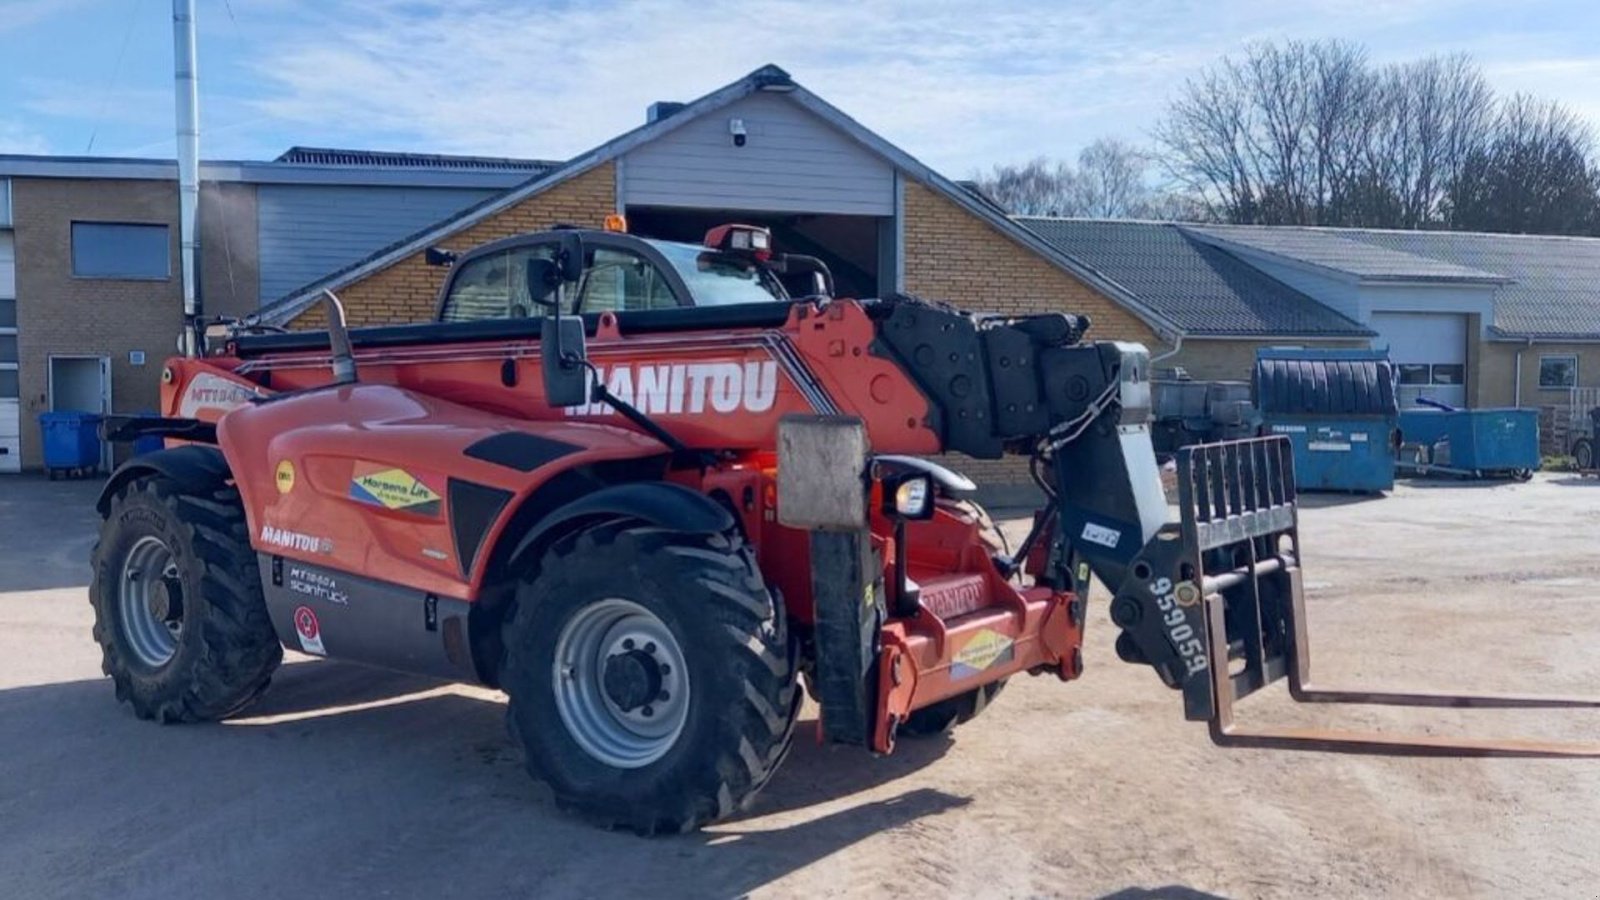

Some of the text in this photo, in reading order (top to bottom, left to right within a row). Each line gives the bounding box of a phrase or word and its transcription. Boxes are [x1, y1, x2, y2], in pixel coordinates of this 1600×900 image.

[260, 525, 320, 552] MANITOU
[290, 580, 350, 606] scantruck
[1150, 577, 1207, 676] 959059
